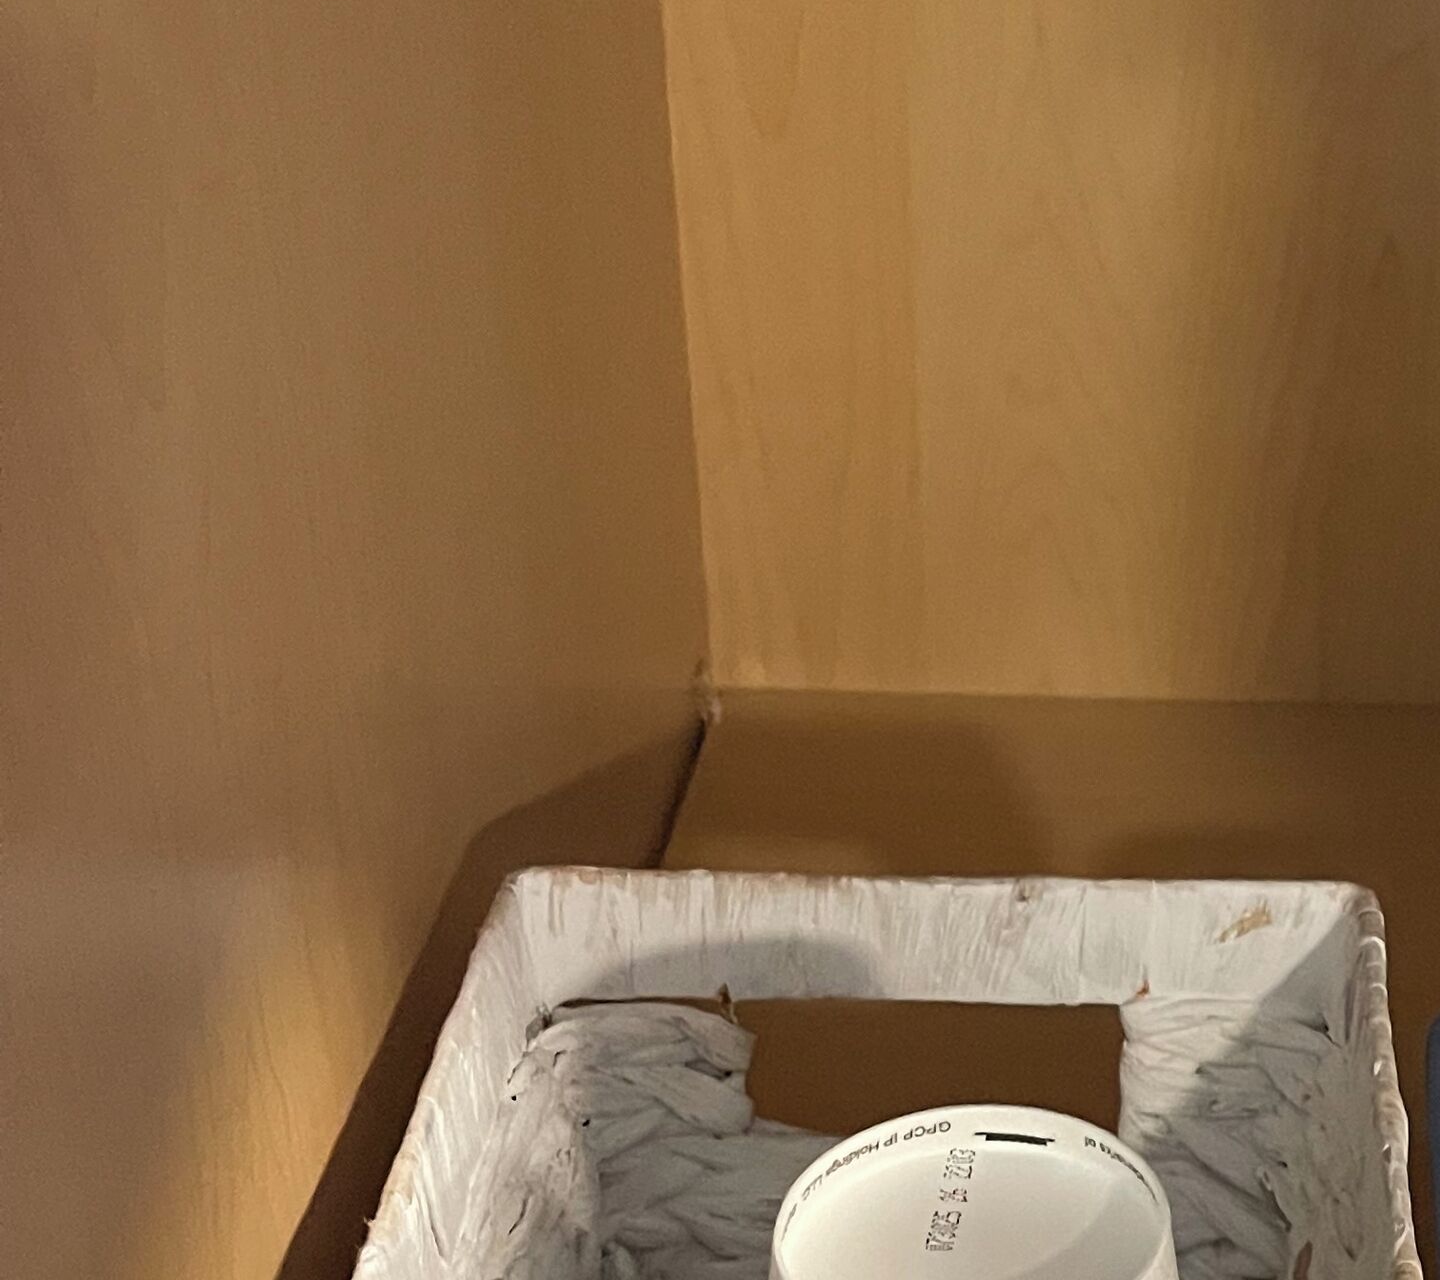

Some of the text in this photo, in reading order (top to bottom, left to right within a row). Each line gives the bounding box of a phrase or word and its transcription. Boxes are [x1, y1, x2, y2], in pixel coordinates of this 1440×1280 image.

[883, 1132, 898, 1148] IP
[903, 1120, 951, 1141] GPCP
[825, 1139, 880, 1177] Holdings
